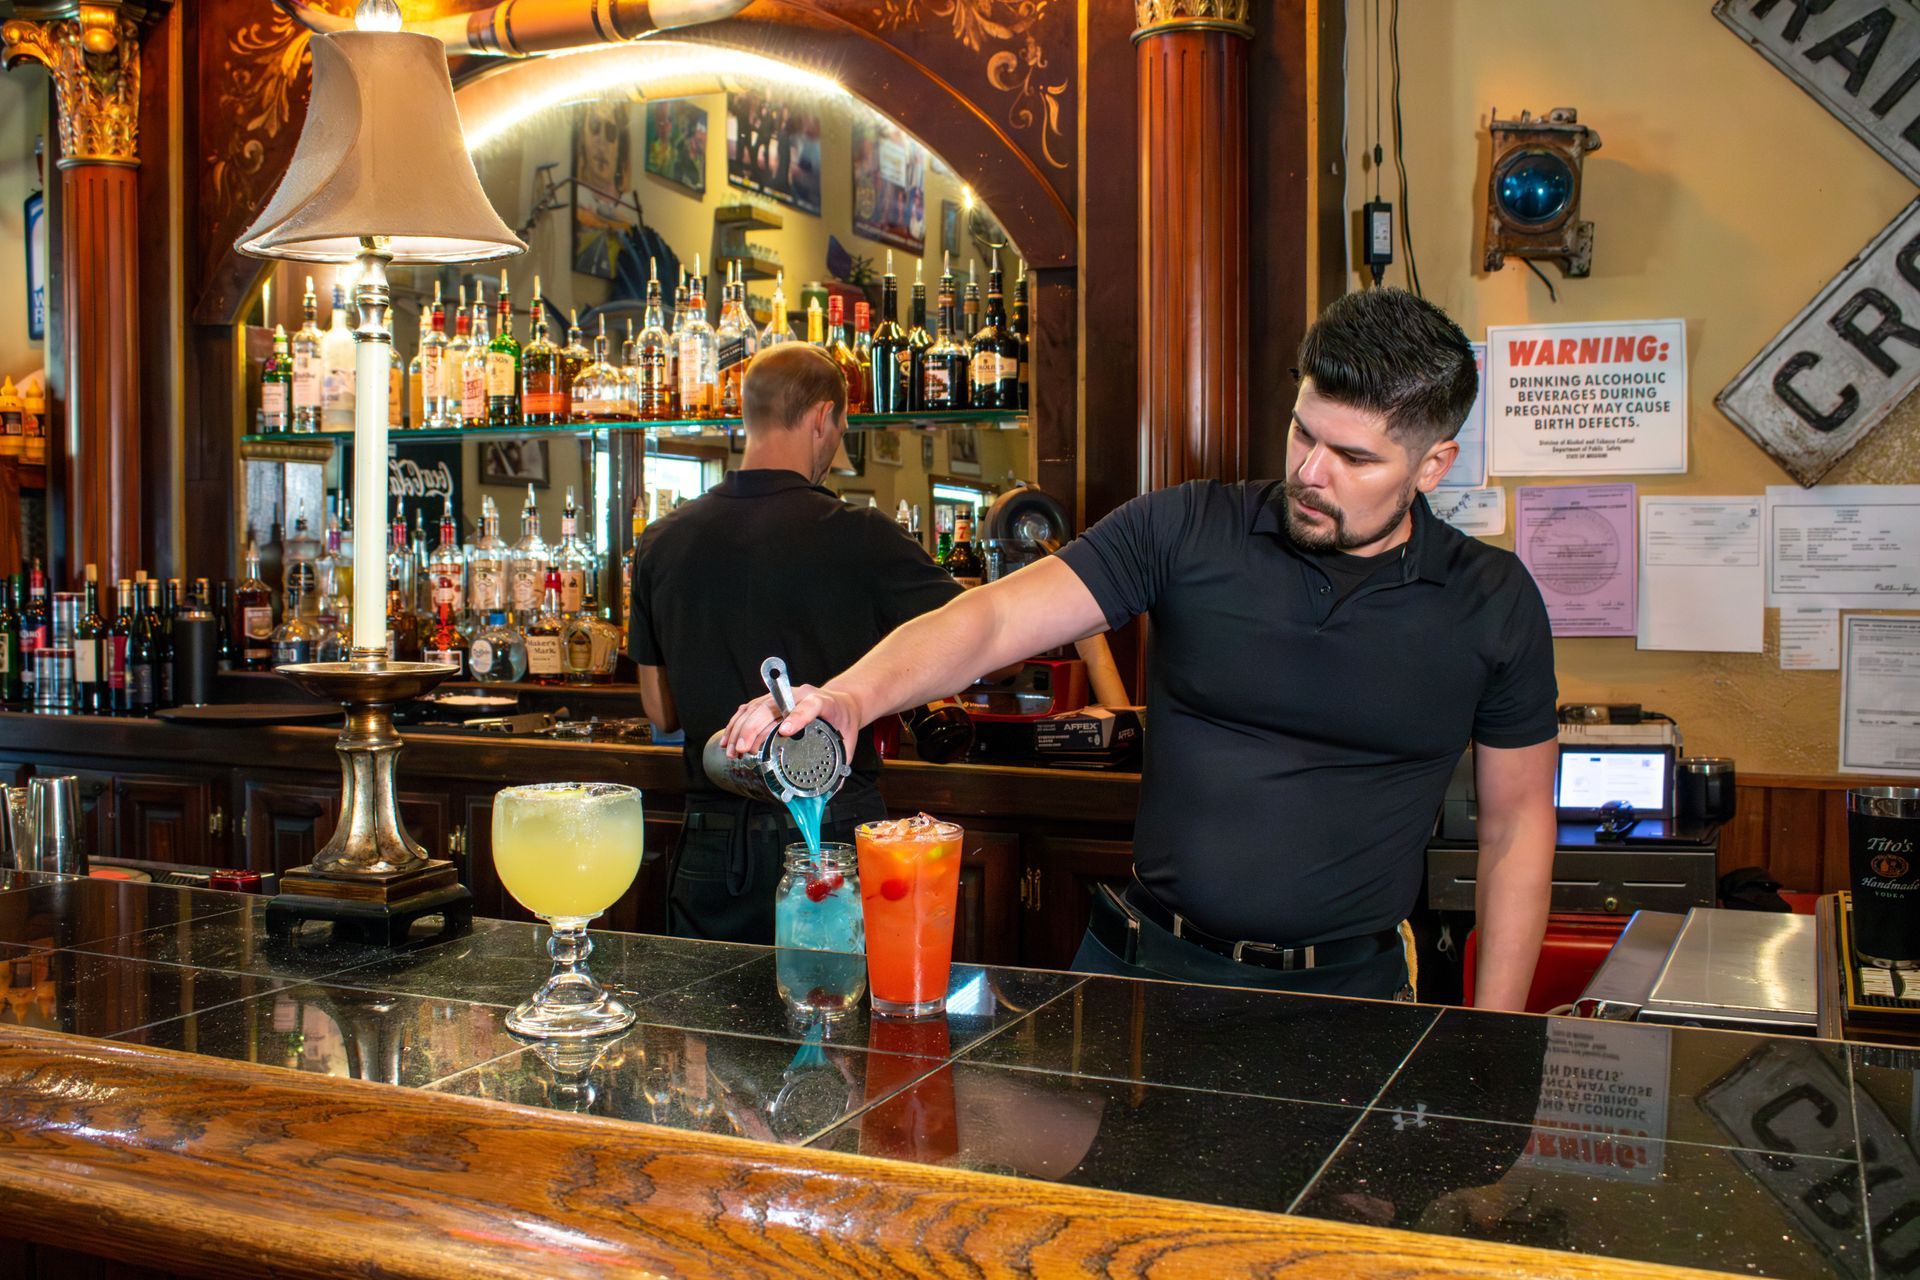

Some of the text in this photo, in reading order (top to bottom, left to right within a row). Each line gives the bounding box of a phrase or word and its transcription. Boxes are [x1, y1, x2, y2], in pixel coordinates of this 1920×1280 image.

[1509, 335, 1670, 366] WARNING:
[1509, 372, 1666, 388] DRINKING ALCOHOLIC
[1518, 387, 1657, 402] BEVERAGES DURING
[1505, 400, 1671, 417] PREGNANCY MAY CAUSE
[1534, 416, 1640, 430] BIRTH DEFECTS.
[958, 526, 967, 541] 7
[1063, 723, 1097, 731] AFFEX
[1867, 837, 1913, 853] Tito's
[1861, 877, 1920, 890] Handmade
